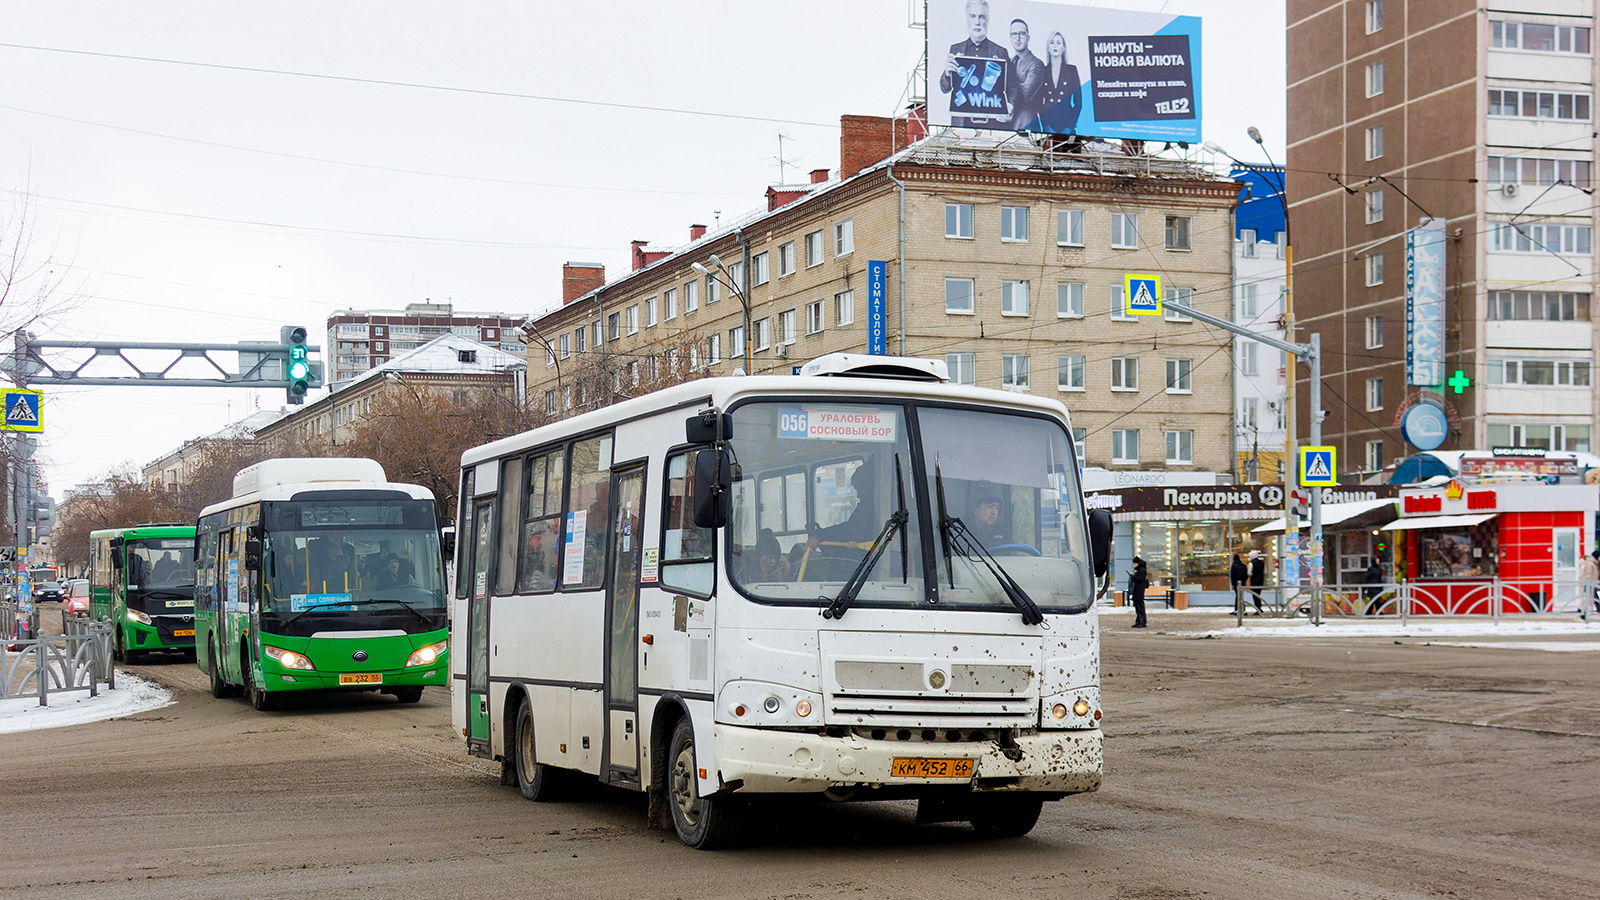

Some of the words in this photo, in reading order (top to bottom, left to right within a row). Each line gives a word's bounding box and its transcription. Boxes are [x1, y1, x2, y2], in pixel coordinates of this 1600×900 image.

[1093, 42, 1144, 54] МИНУТЫ
[1094, 56, 1134, 67] НОВАЯ
[1136, 54, 1185, 66] ВАЛЮТА
[1096, 80, 1128, 88] Меняйте
[1128, 80, 1157, 90] минуты
[968, 92, 1002, 107] Wink
[1130, 89, 1148, 99] кофе
[1154, 98, 1189, 114] TELE2
[873, 265, 881, 354] СТОМАТОЛОГИ
[781, 413, 807, 432] 056
[820, 413, 881, 424] УРАЛОБУВЬ
[810, 425, 868, 436] СОСНОВЫЙ
[871, 428, 892, 436] БОР
[1163, 488, 1252, 509] Пекарня
[899, 764, 916, 774] КМ
[922, 761, 947, 775] 452
[955, 761, 968, 771] 66
